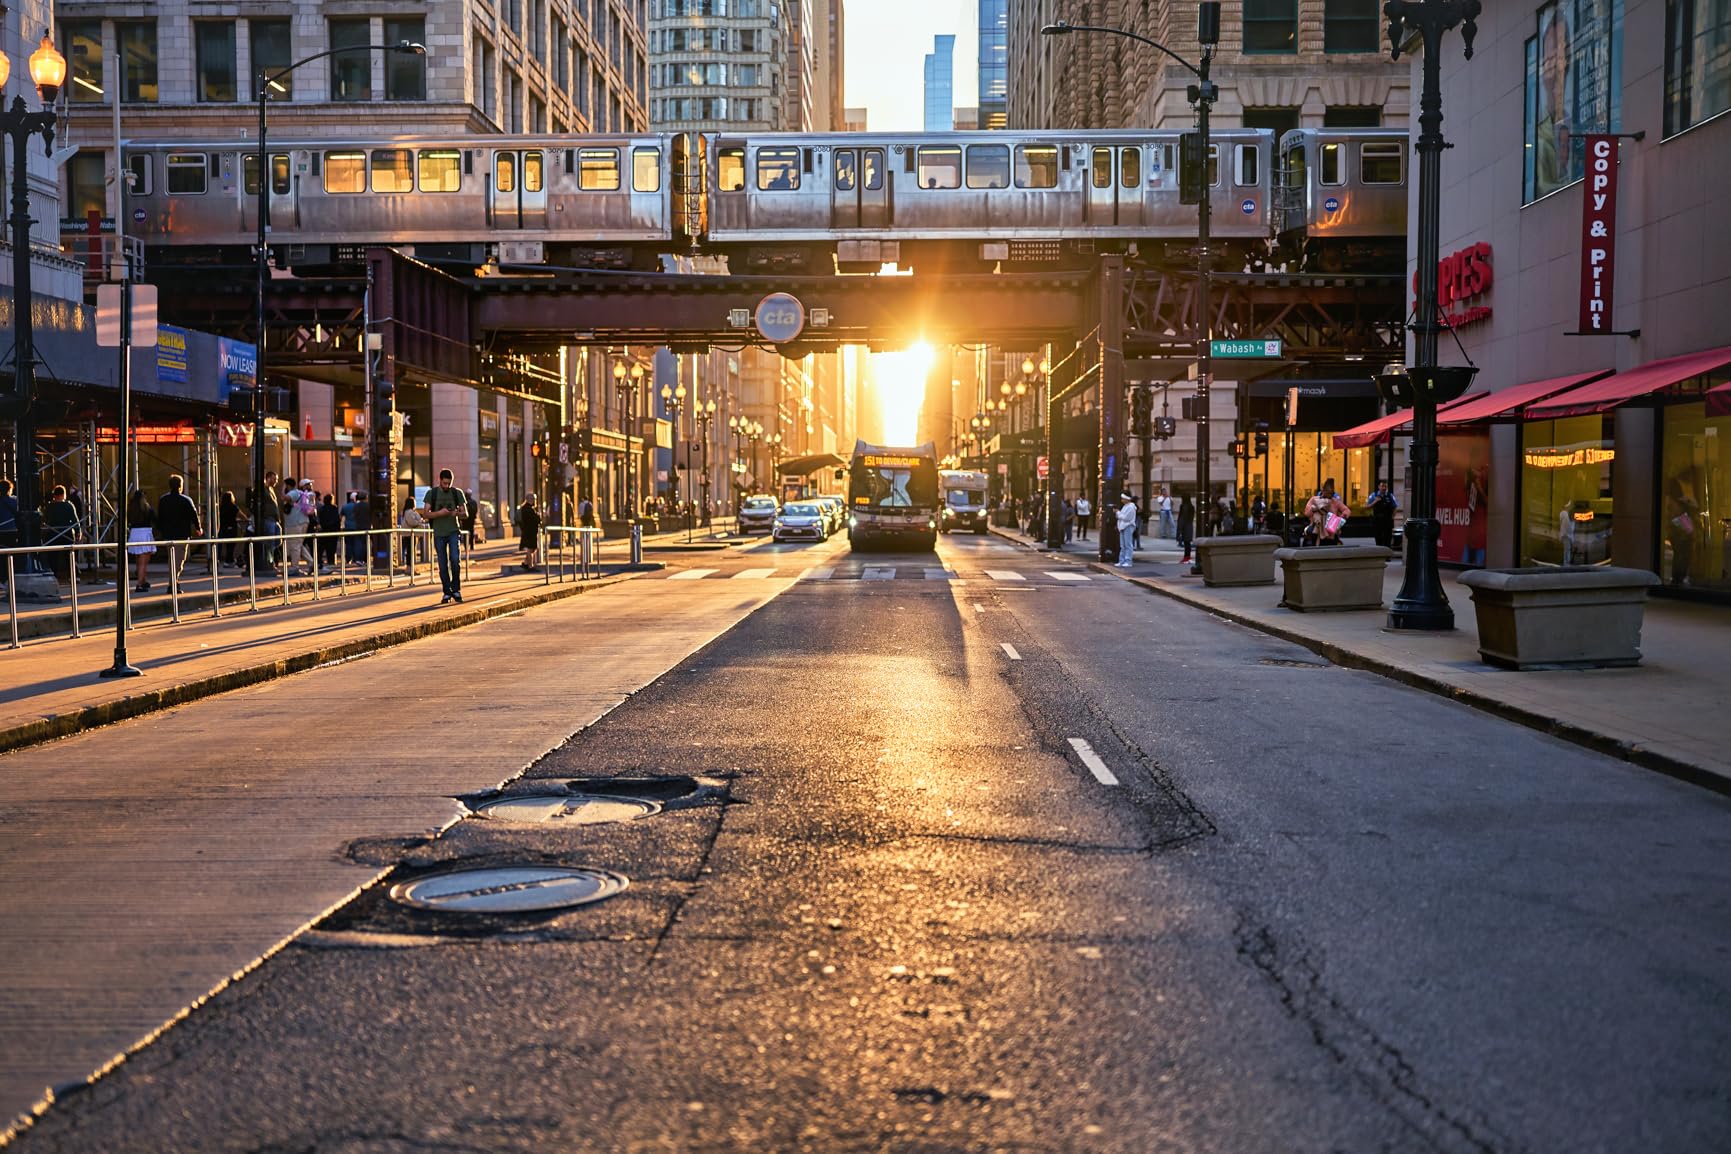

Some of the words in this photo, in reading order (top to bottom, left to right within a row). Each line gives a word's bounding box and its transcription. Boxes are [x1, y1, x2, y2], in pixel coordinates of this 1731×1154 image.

[1593, 140, 1610, 210] Copy
[1242, 202, 1255, 210] cta
[1590, 220, 1607, 237] &
[1412, 241, 1492, 308] PLES
[1590, 249, 1606, 329] Print
[763, 309, 796, 325] cta
[1220, 343, 1255, 353] Wabash
[220, 352, 238, 371] NOW
[864, 456, 876, 467] 151
[1454, 508, 1471, 526] HUB
